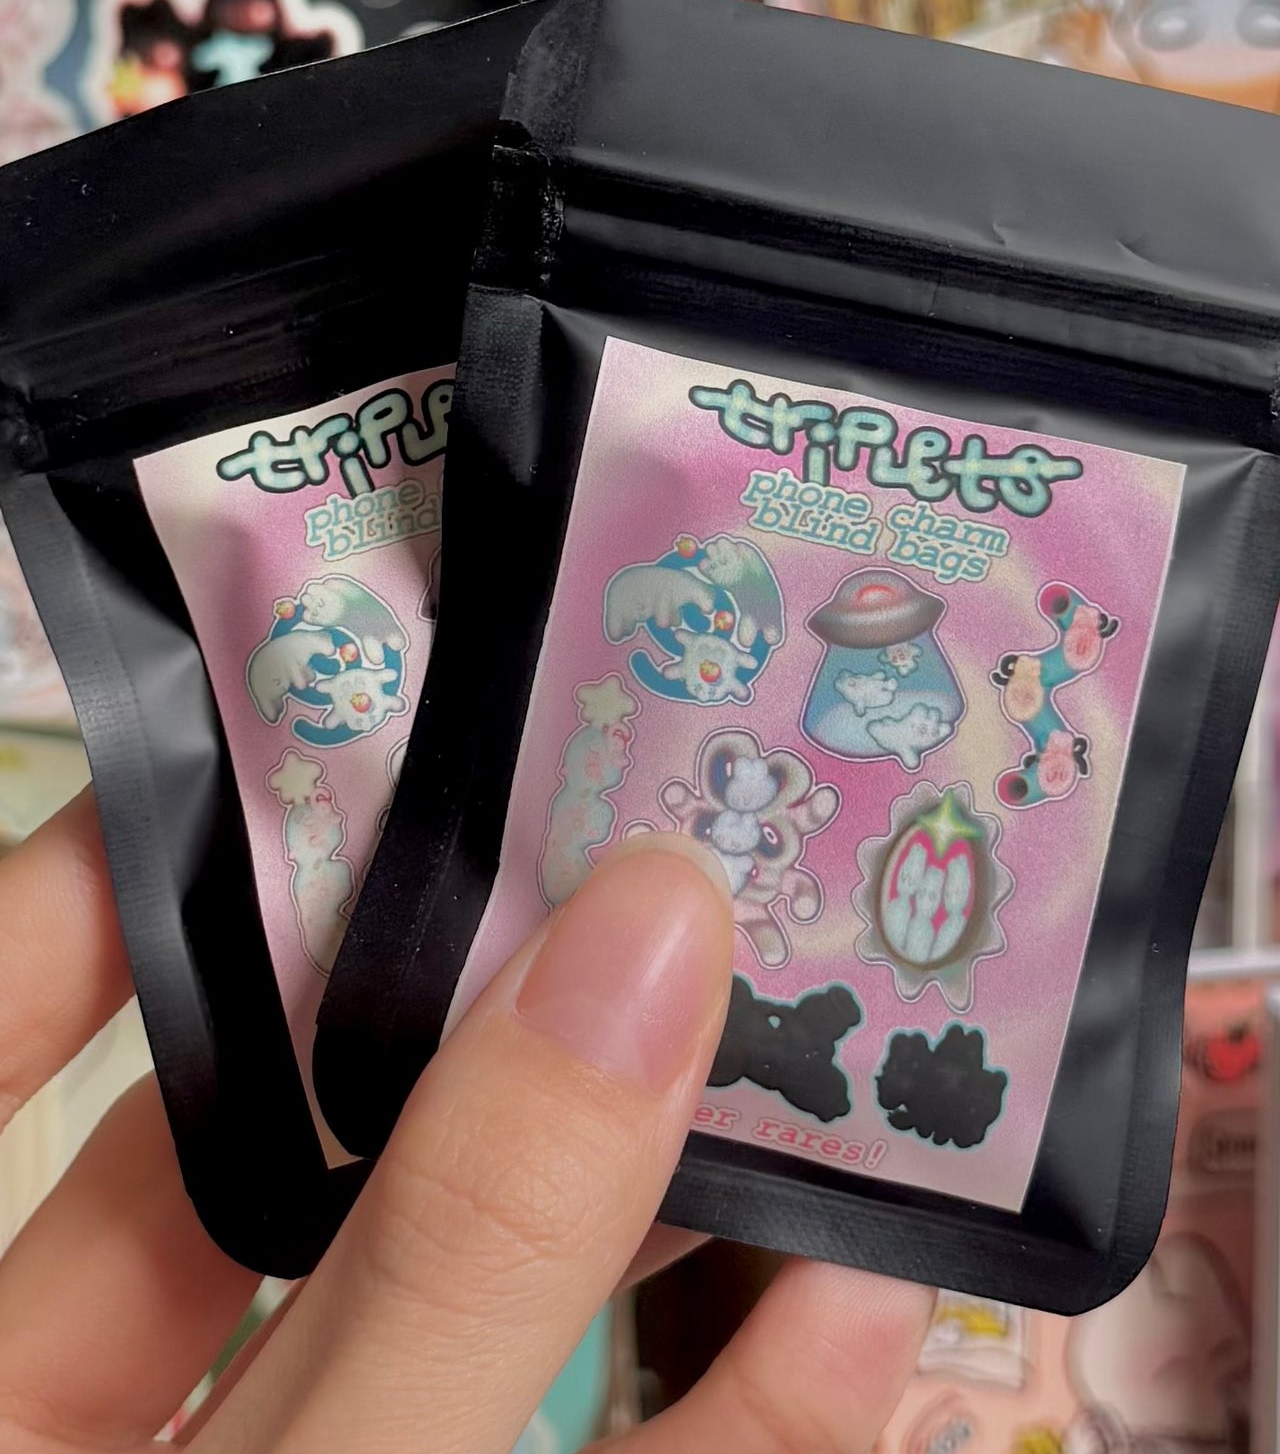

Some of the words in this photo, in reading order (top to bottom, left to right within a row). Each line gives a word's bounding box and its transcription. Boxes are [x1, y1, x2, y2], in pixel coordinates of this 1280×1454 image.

[217, 379, 455, 499] triple
[307, 482, 420, 544] phone
[326, 499, 441, 557] blind
[742, 471, 869, 520] phone
[888, 503, 1007, 554] charm
[754, 499, 880, 551] blind
[890, 532, 988, 580] bags
[694, 1105, 738, 1127] er
[756, 1119, 885, 1167] rares!
